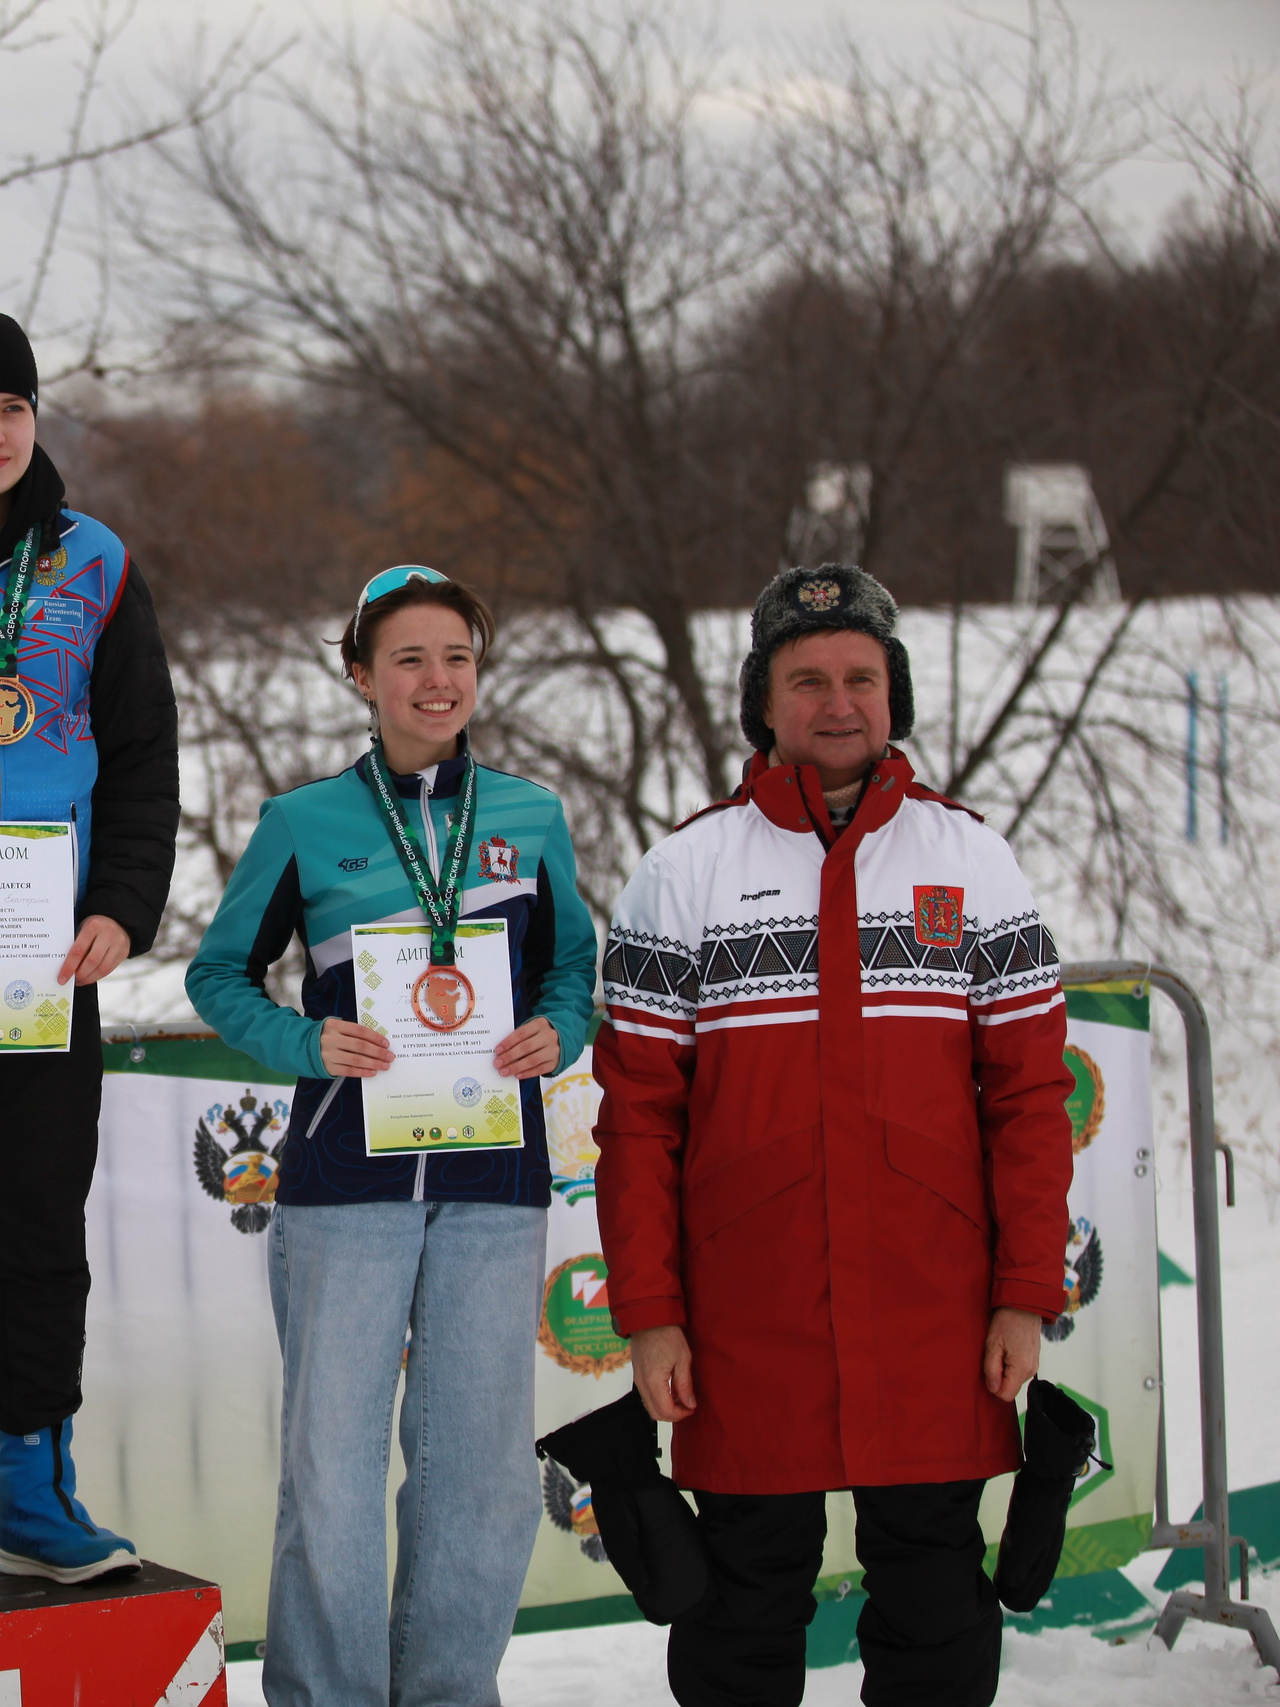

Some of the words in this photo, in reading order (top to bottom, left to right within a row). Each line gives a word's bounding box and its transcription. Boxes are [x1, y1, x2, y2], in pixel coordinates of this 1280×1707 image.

[43, 600, 67, 608] Russian
[44, 608, 82, 618] Orienteering
[389, 809, 416, 861] СПОРТИВНЫЕ
[454, 809, 469, 857] СПОРТИВНЫЕ
[411, 861, 443, 926] ВСЕРОССИЙСКИЕ
[396, 945, 464, 965] ДИПМ
[442, 1005, 448, 1014] 3
